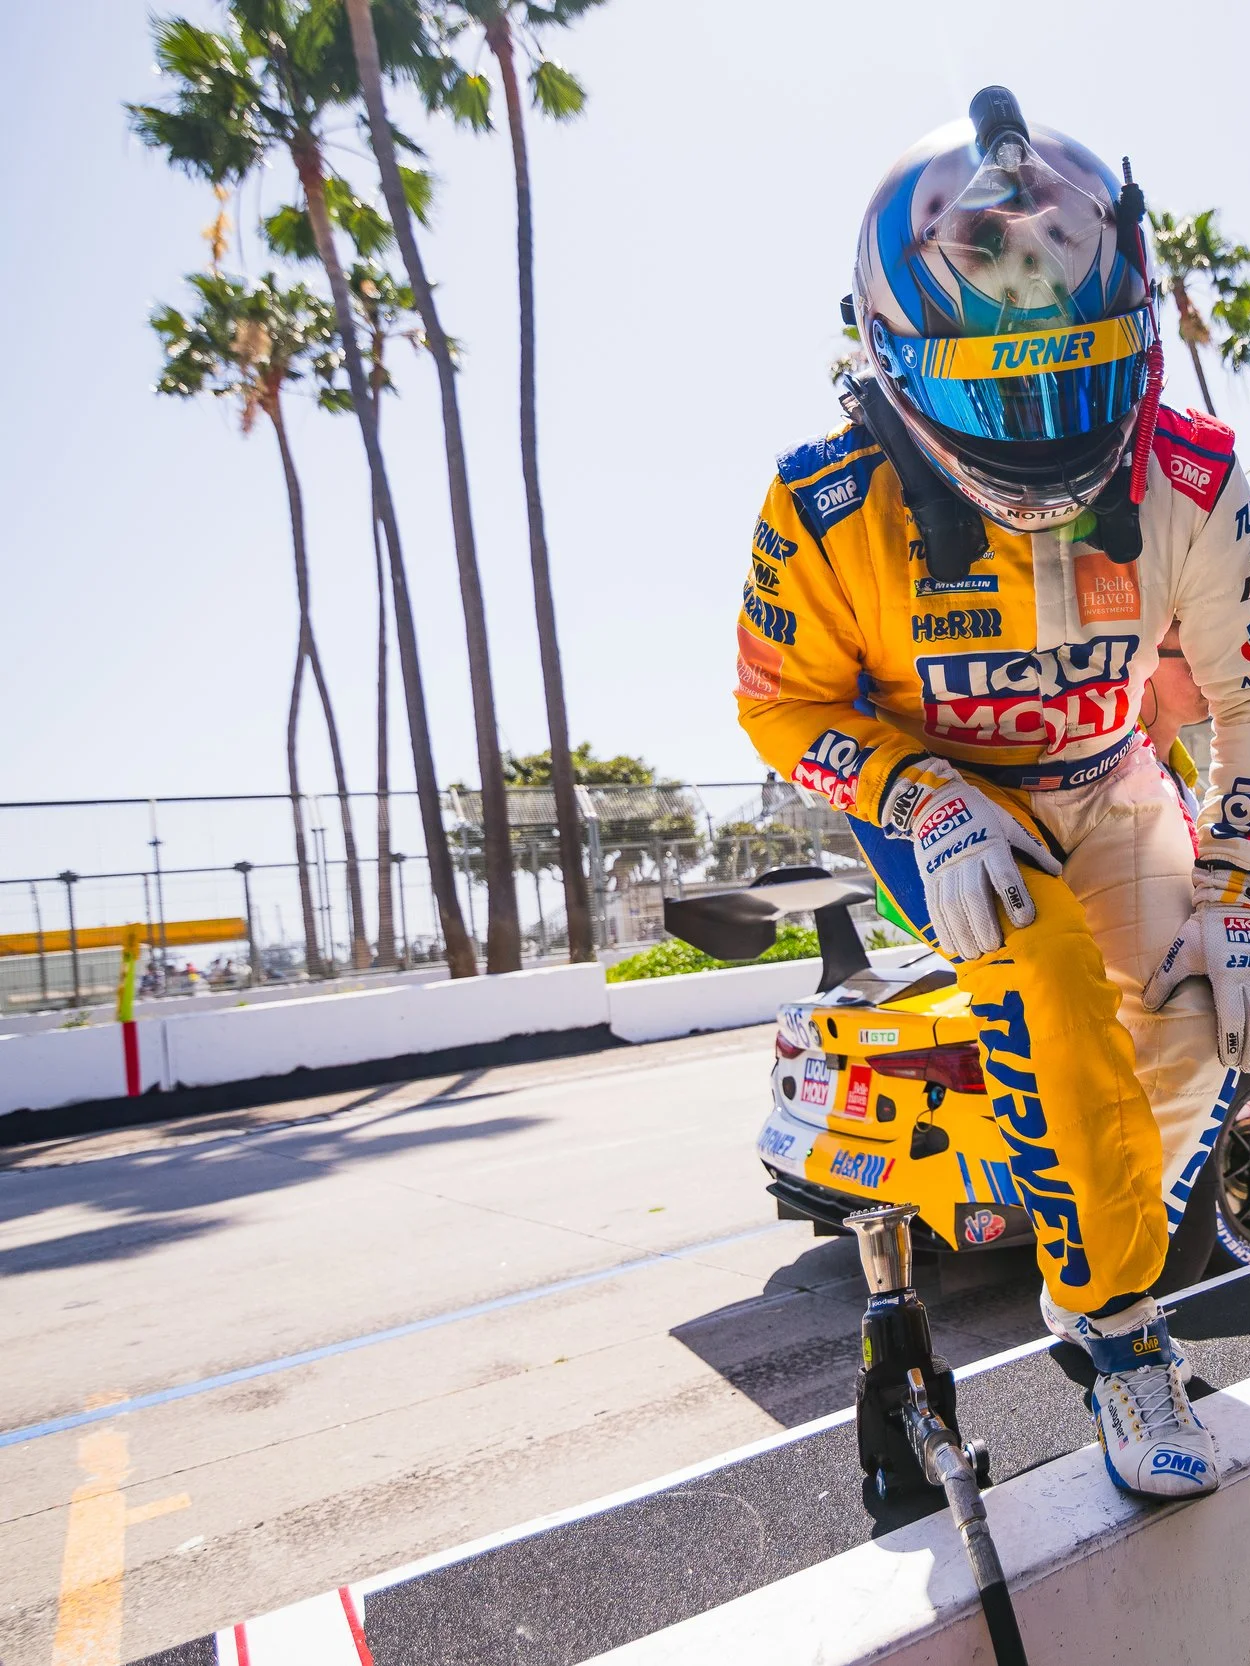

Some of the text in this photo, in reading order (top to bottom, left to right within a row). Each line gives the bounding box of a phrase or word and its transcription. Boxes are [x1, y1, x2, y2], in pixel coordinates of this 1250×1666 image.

[991, 331, 1095, 371] TURNER
[1171, 459, 1211, 488] OMP
[817, 480, 857, 511] OMP
[753, 560, 780, 588] MP
[1095, 577, 1134, 592] Belle
[1082, 591, 1135, 607] Haven
[1084, 607, 1134, 617] INVESTMENTS
[928, 641, 1129, 702] LIQUI
[937, 684, 1127, 755] MOLY
[891, 785, 919, 827] OMP
[918, 799, 964, 838] MOLY
[923, 811, 971, 849] LIQUI
[926, 827, 988, 874] TURNER
[1007, 886, 1023, 910] OMP
[1162, 937, 1185, 973] TURNER
[870, 1031, 897, 1043] GTD
[1229, 1032, 1239, 1054] OMP
[802, 1080, 829, 1105] MOLY
[971, 990, 1092, 1287] TURNER
[965, 1209, 993, 1243] VP
[1133, 1338, 1160, 1353] OMP
[1152, 1453, 1207, 1477] OMP
